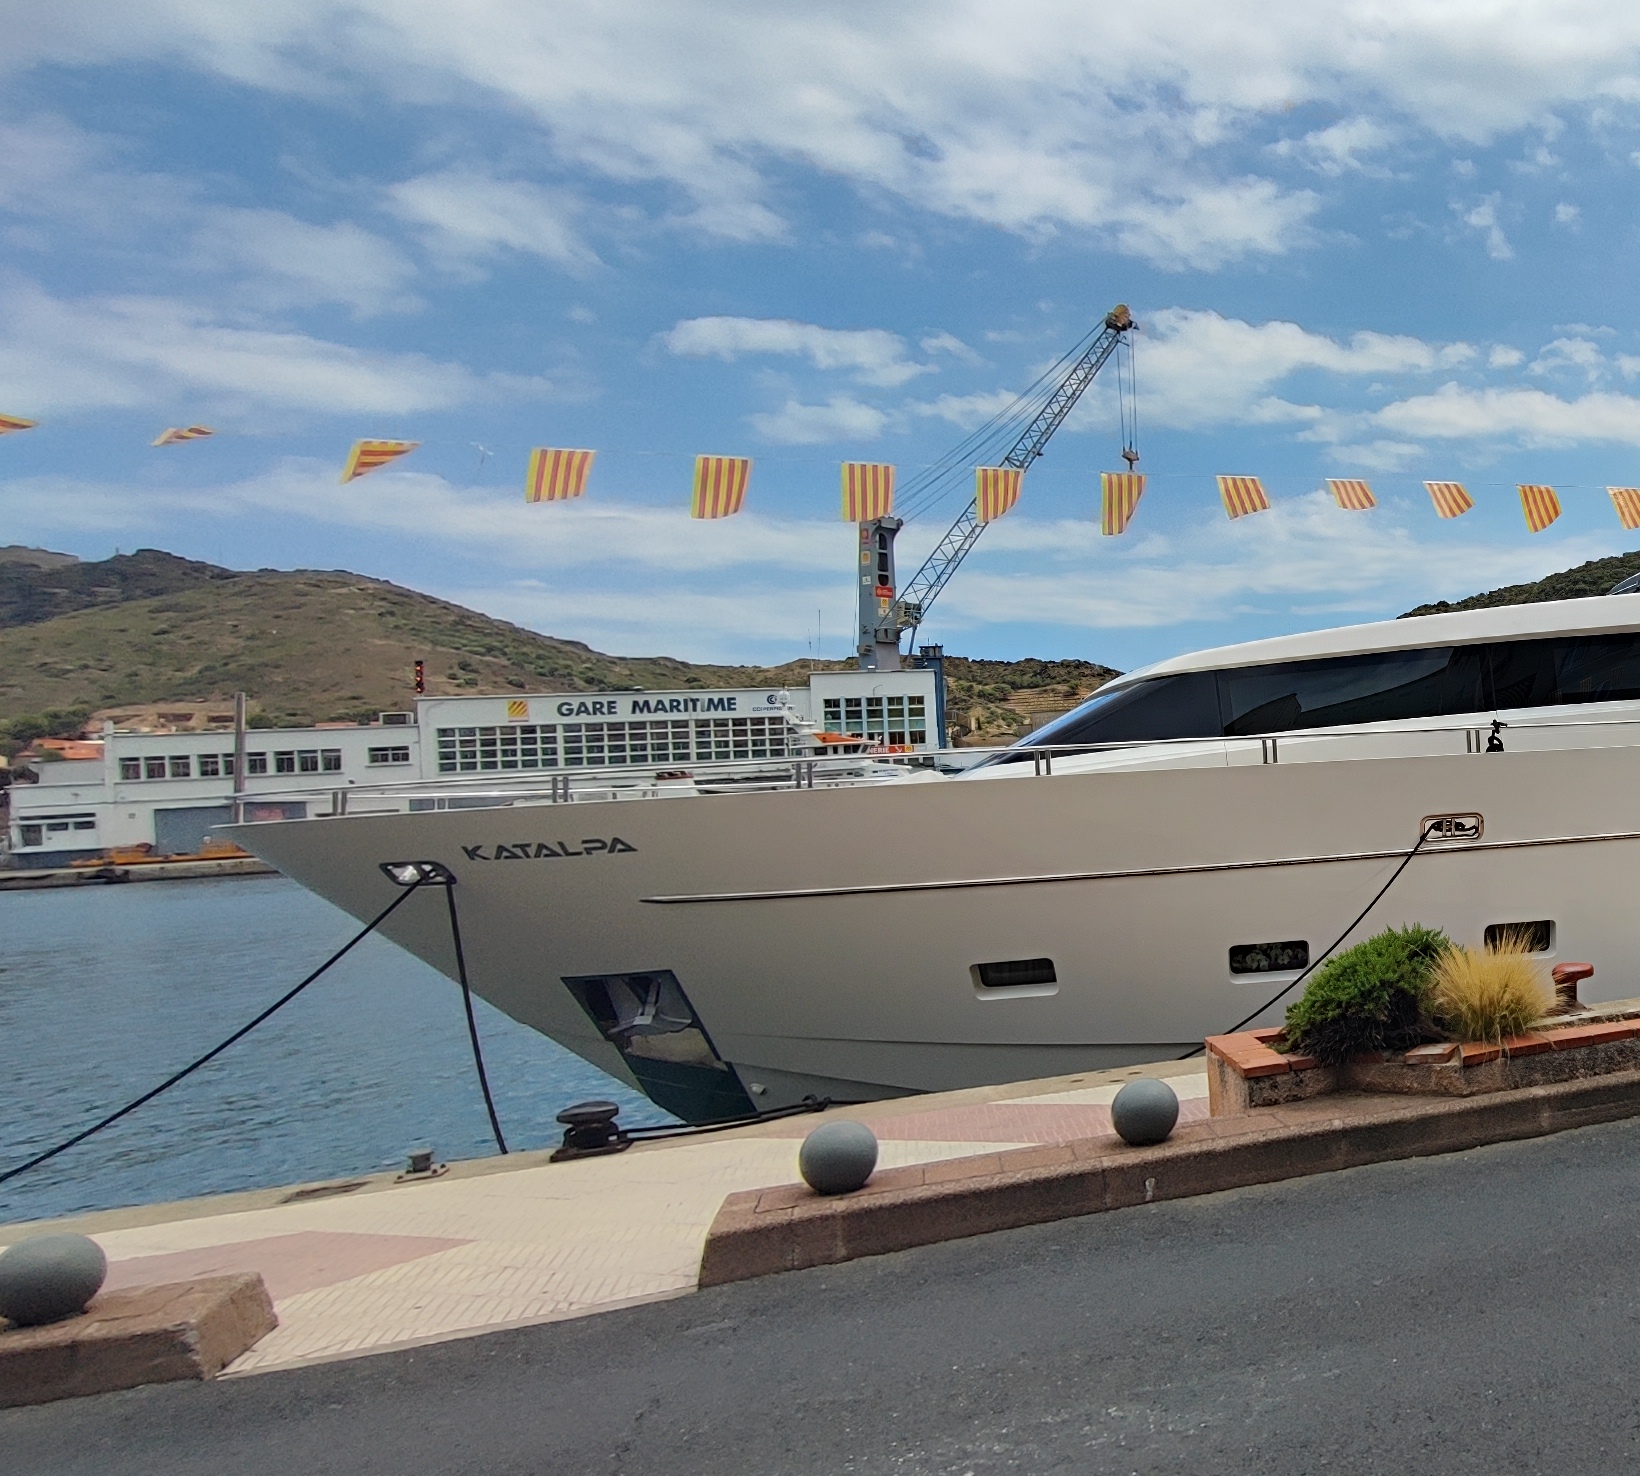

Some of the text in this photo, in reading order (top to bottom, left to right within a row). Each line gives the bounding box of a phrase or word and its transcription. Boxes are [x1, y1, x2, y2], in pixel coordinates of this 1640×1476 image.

[557, 697, 737, 716] GARE MARITIME
[460, 837, 638, 861] KATALPA
